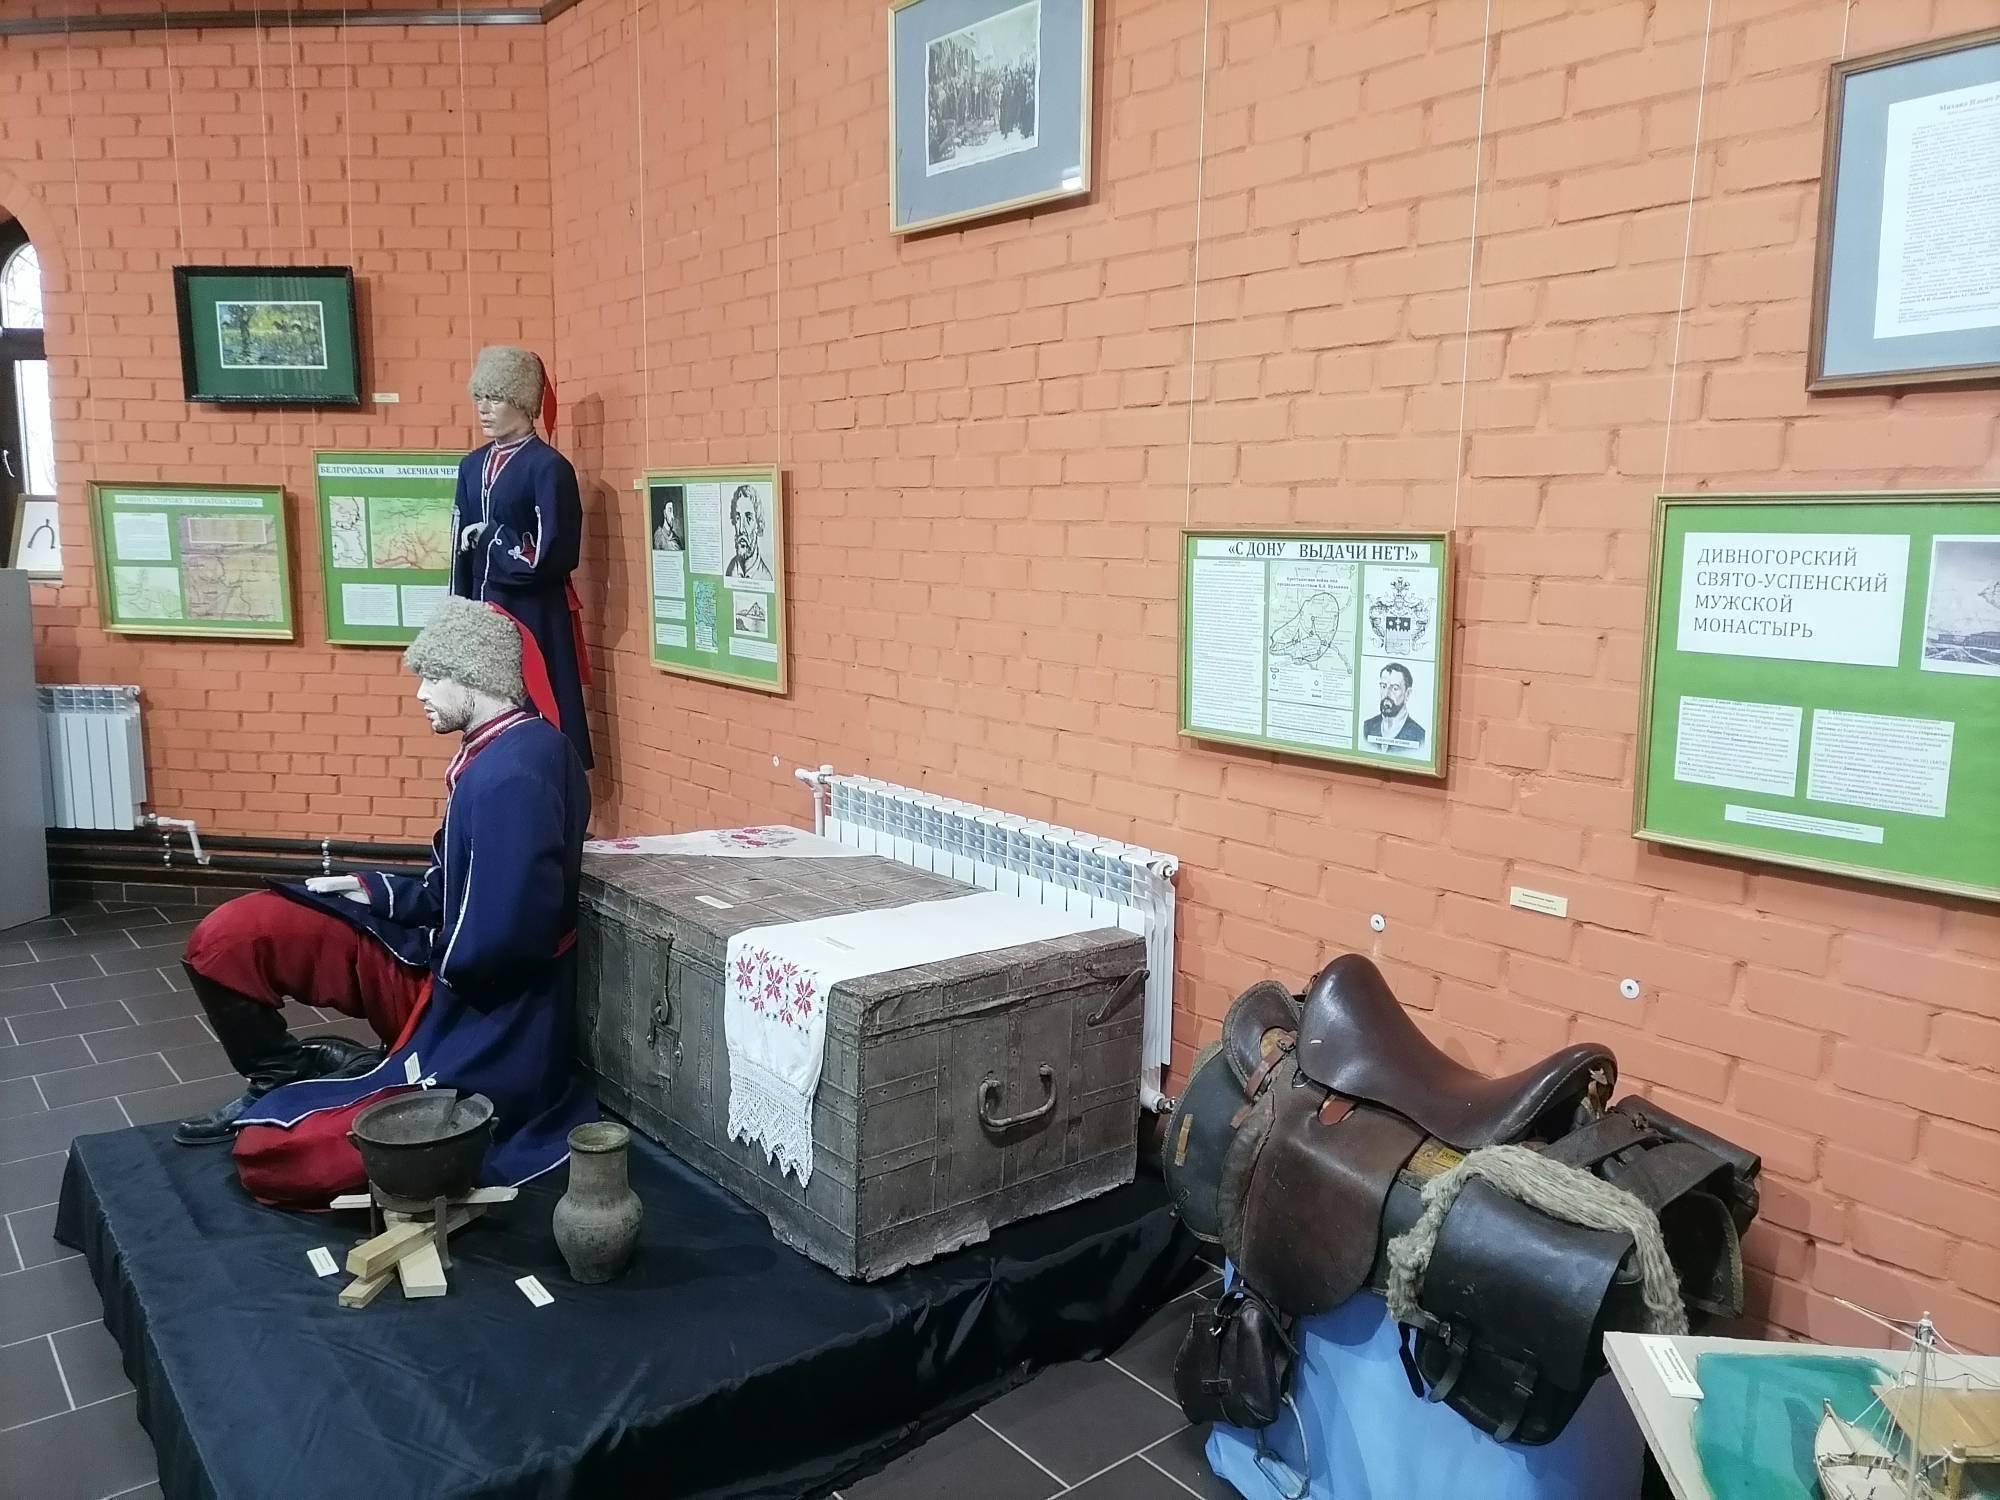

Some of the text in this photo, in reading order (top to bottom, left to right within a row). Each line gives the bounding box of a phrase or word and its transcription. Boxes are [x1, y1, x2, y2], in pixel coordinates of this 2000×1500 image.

[320, 466, 459, 476] БЕЛГОРОДСКАЯ ЗАСЕЧНАЯ ЧЕР
[1228, 541, 1419, 561] «С ДОНУ ВЫДАЧИ НЕТ!»
[1697, 546, 1858, 567] ДИВНОГОРСКИЙ
[1696, 571, 1889, 593] СВЯТО-УСПЕНСКИЙ
[1695, 594, 1793, 614] МУЖСКОЙ
[1693, 617, 1814, 638] МОНАСТЫРЬ
